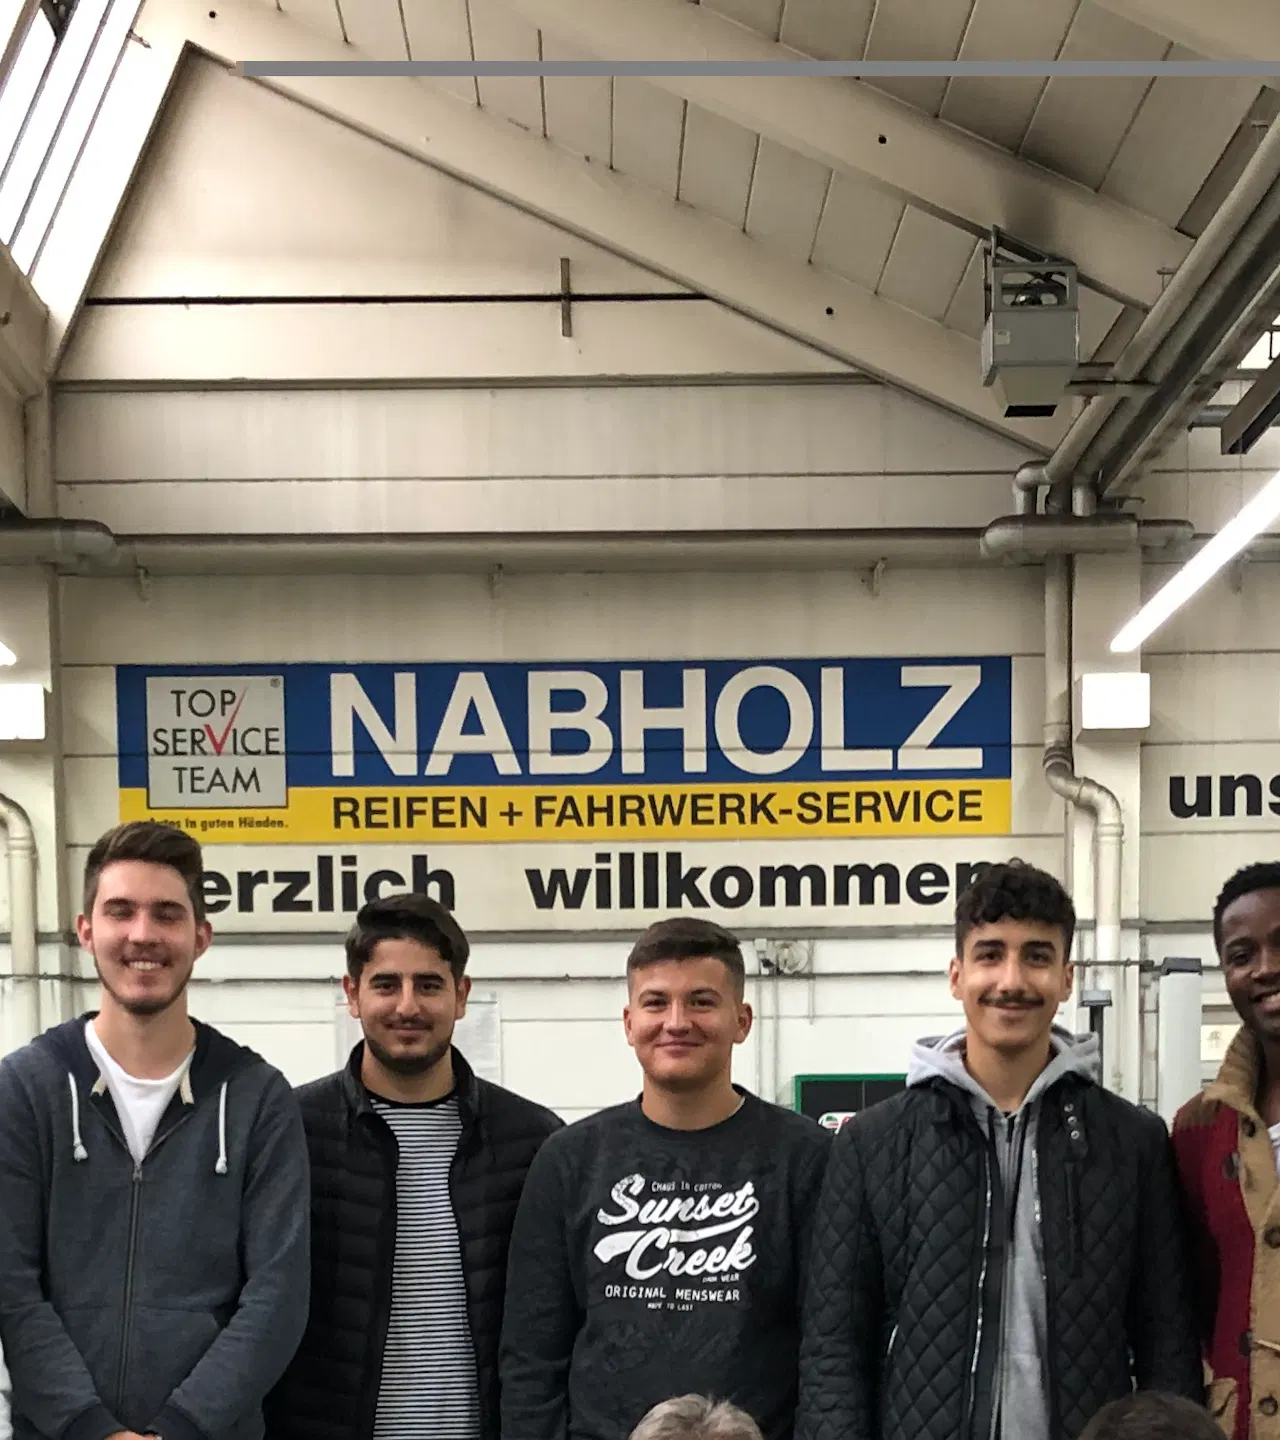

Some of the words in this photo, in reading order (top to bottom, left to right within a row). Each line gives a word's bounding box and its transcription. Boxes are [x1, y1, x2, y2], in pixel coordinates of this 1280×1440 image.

[170, 689, 237, 718] TOP
[329, 664, 984, 777] NABHOLZ
[152, 725, 281, 757] SERVICE
[172, 766, 261, 794] TEAM
[333, 795, 488, 829] REIFEN
[534, 788, 983, 829] FAHRWERK-SERVICE
[203, 854, 455, 913] erzlich
[597, 1173, 760, 1226] Sunset
[625, 1225, 757, 1280] Creek
[605, 1285, 667, 1299] ORIGINAL
[675, 1288, 740, 1302] MENSWEAR
